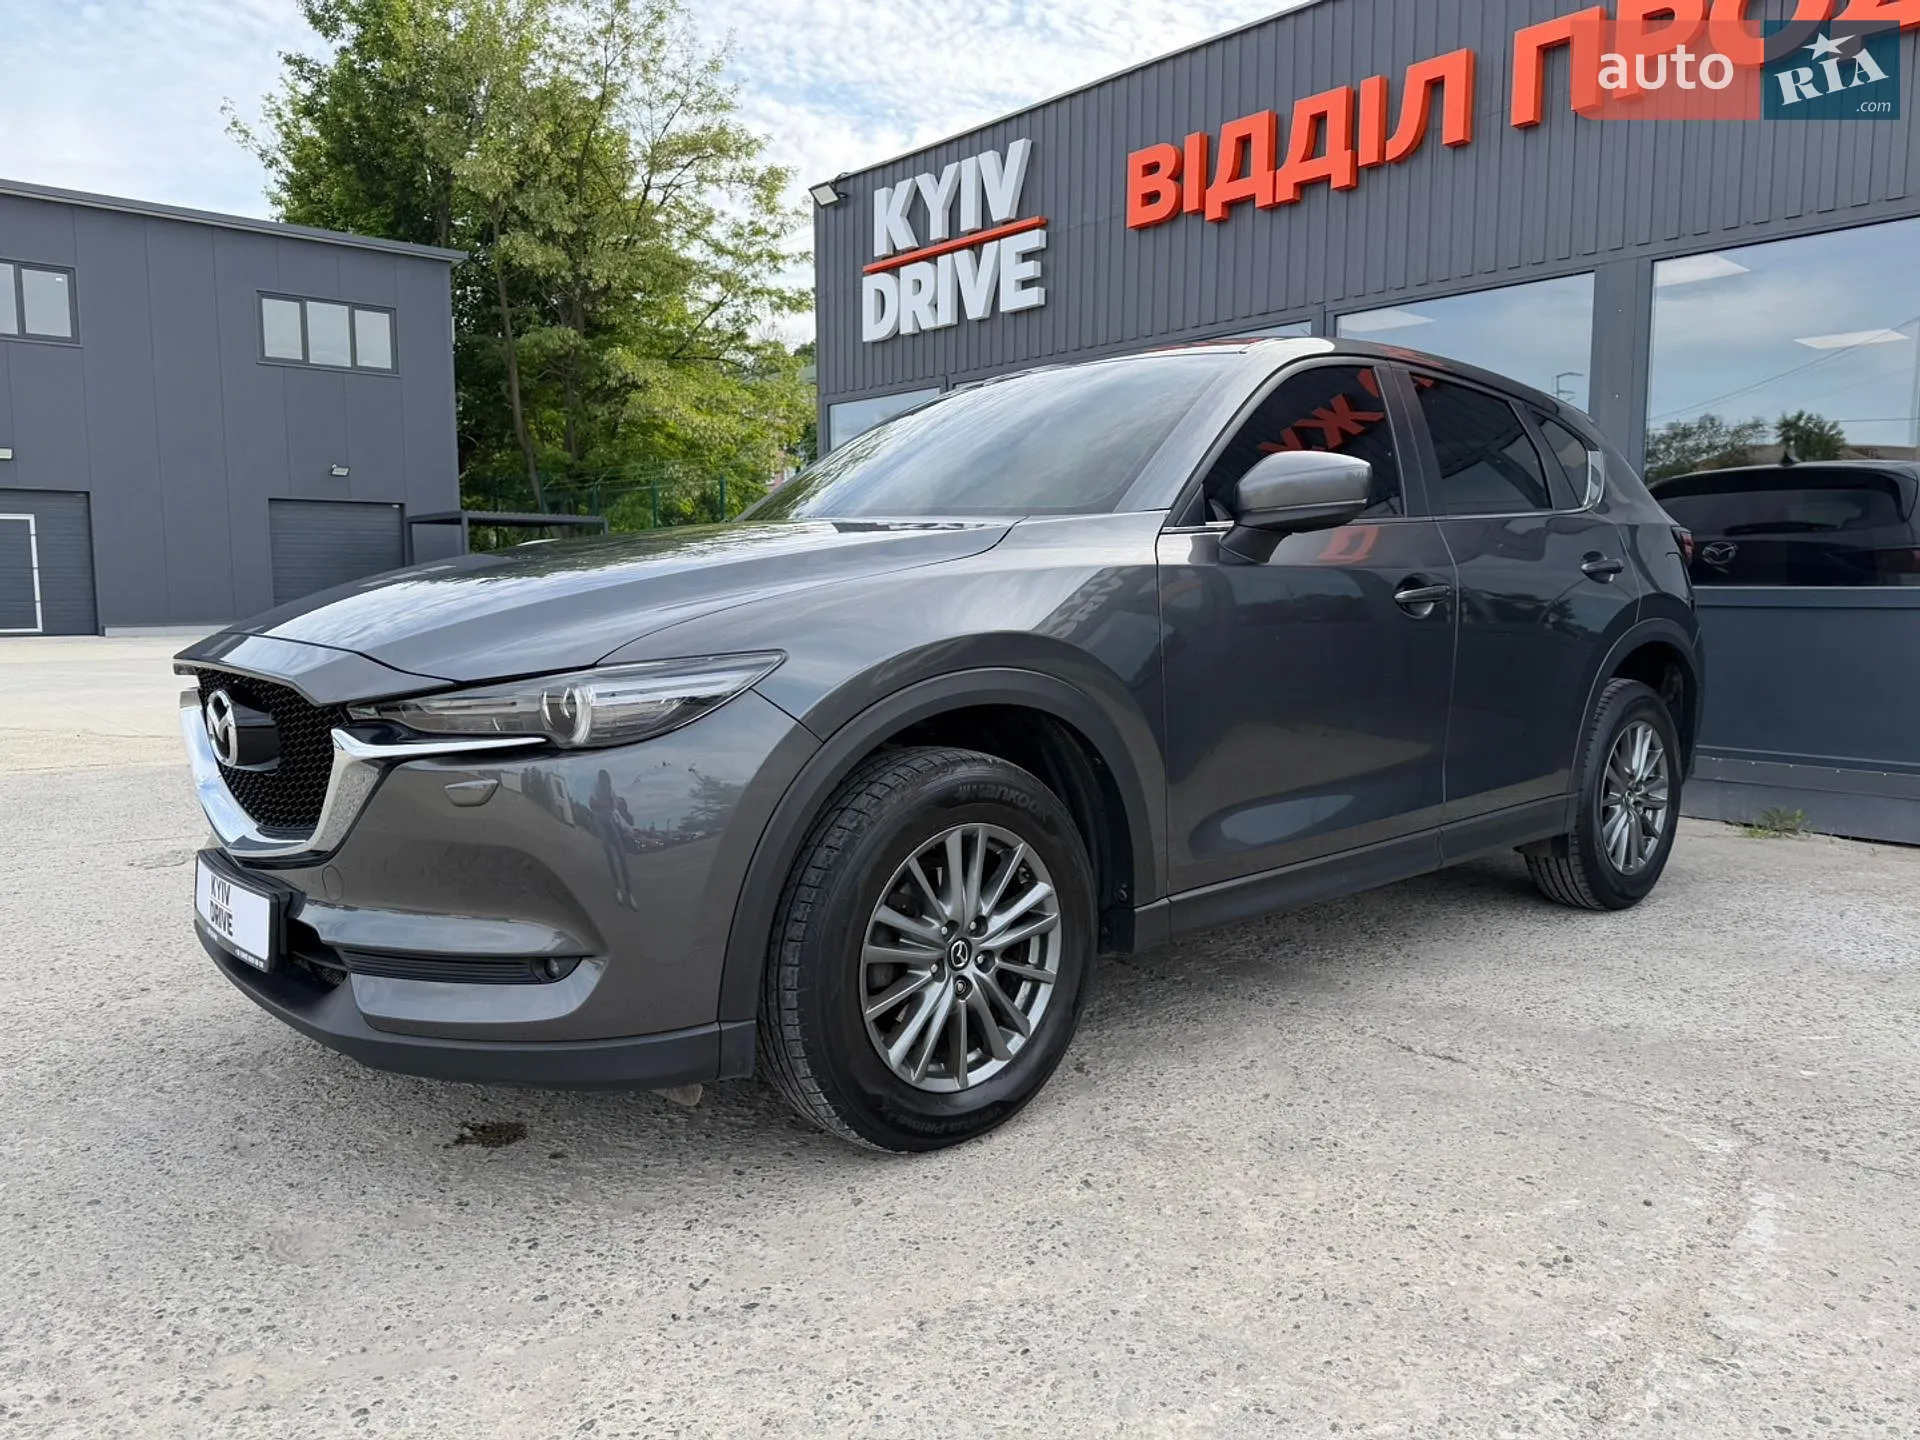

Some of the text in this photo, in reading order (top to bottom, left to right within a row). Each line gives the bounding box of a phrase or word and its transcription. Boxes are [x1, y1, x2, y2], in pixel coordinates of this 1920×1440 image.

[1126, 48, 1475, 230] ВІДДІЛ
[874, 138, 1032, 257] KYIV
[862, 229, 1047, 342] DRIVE
[209, 899, 233, 937] DRIVE
[210, 873, 231, 906] KYIV
